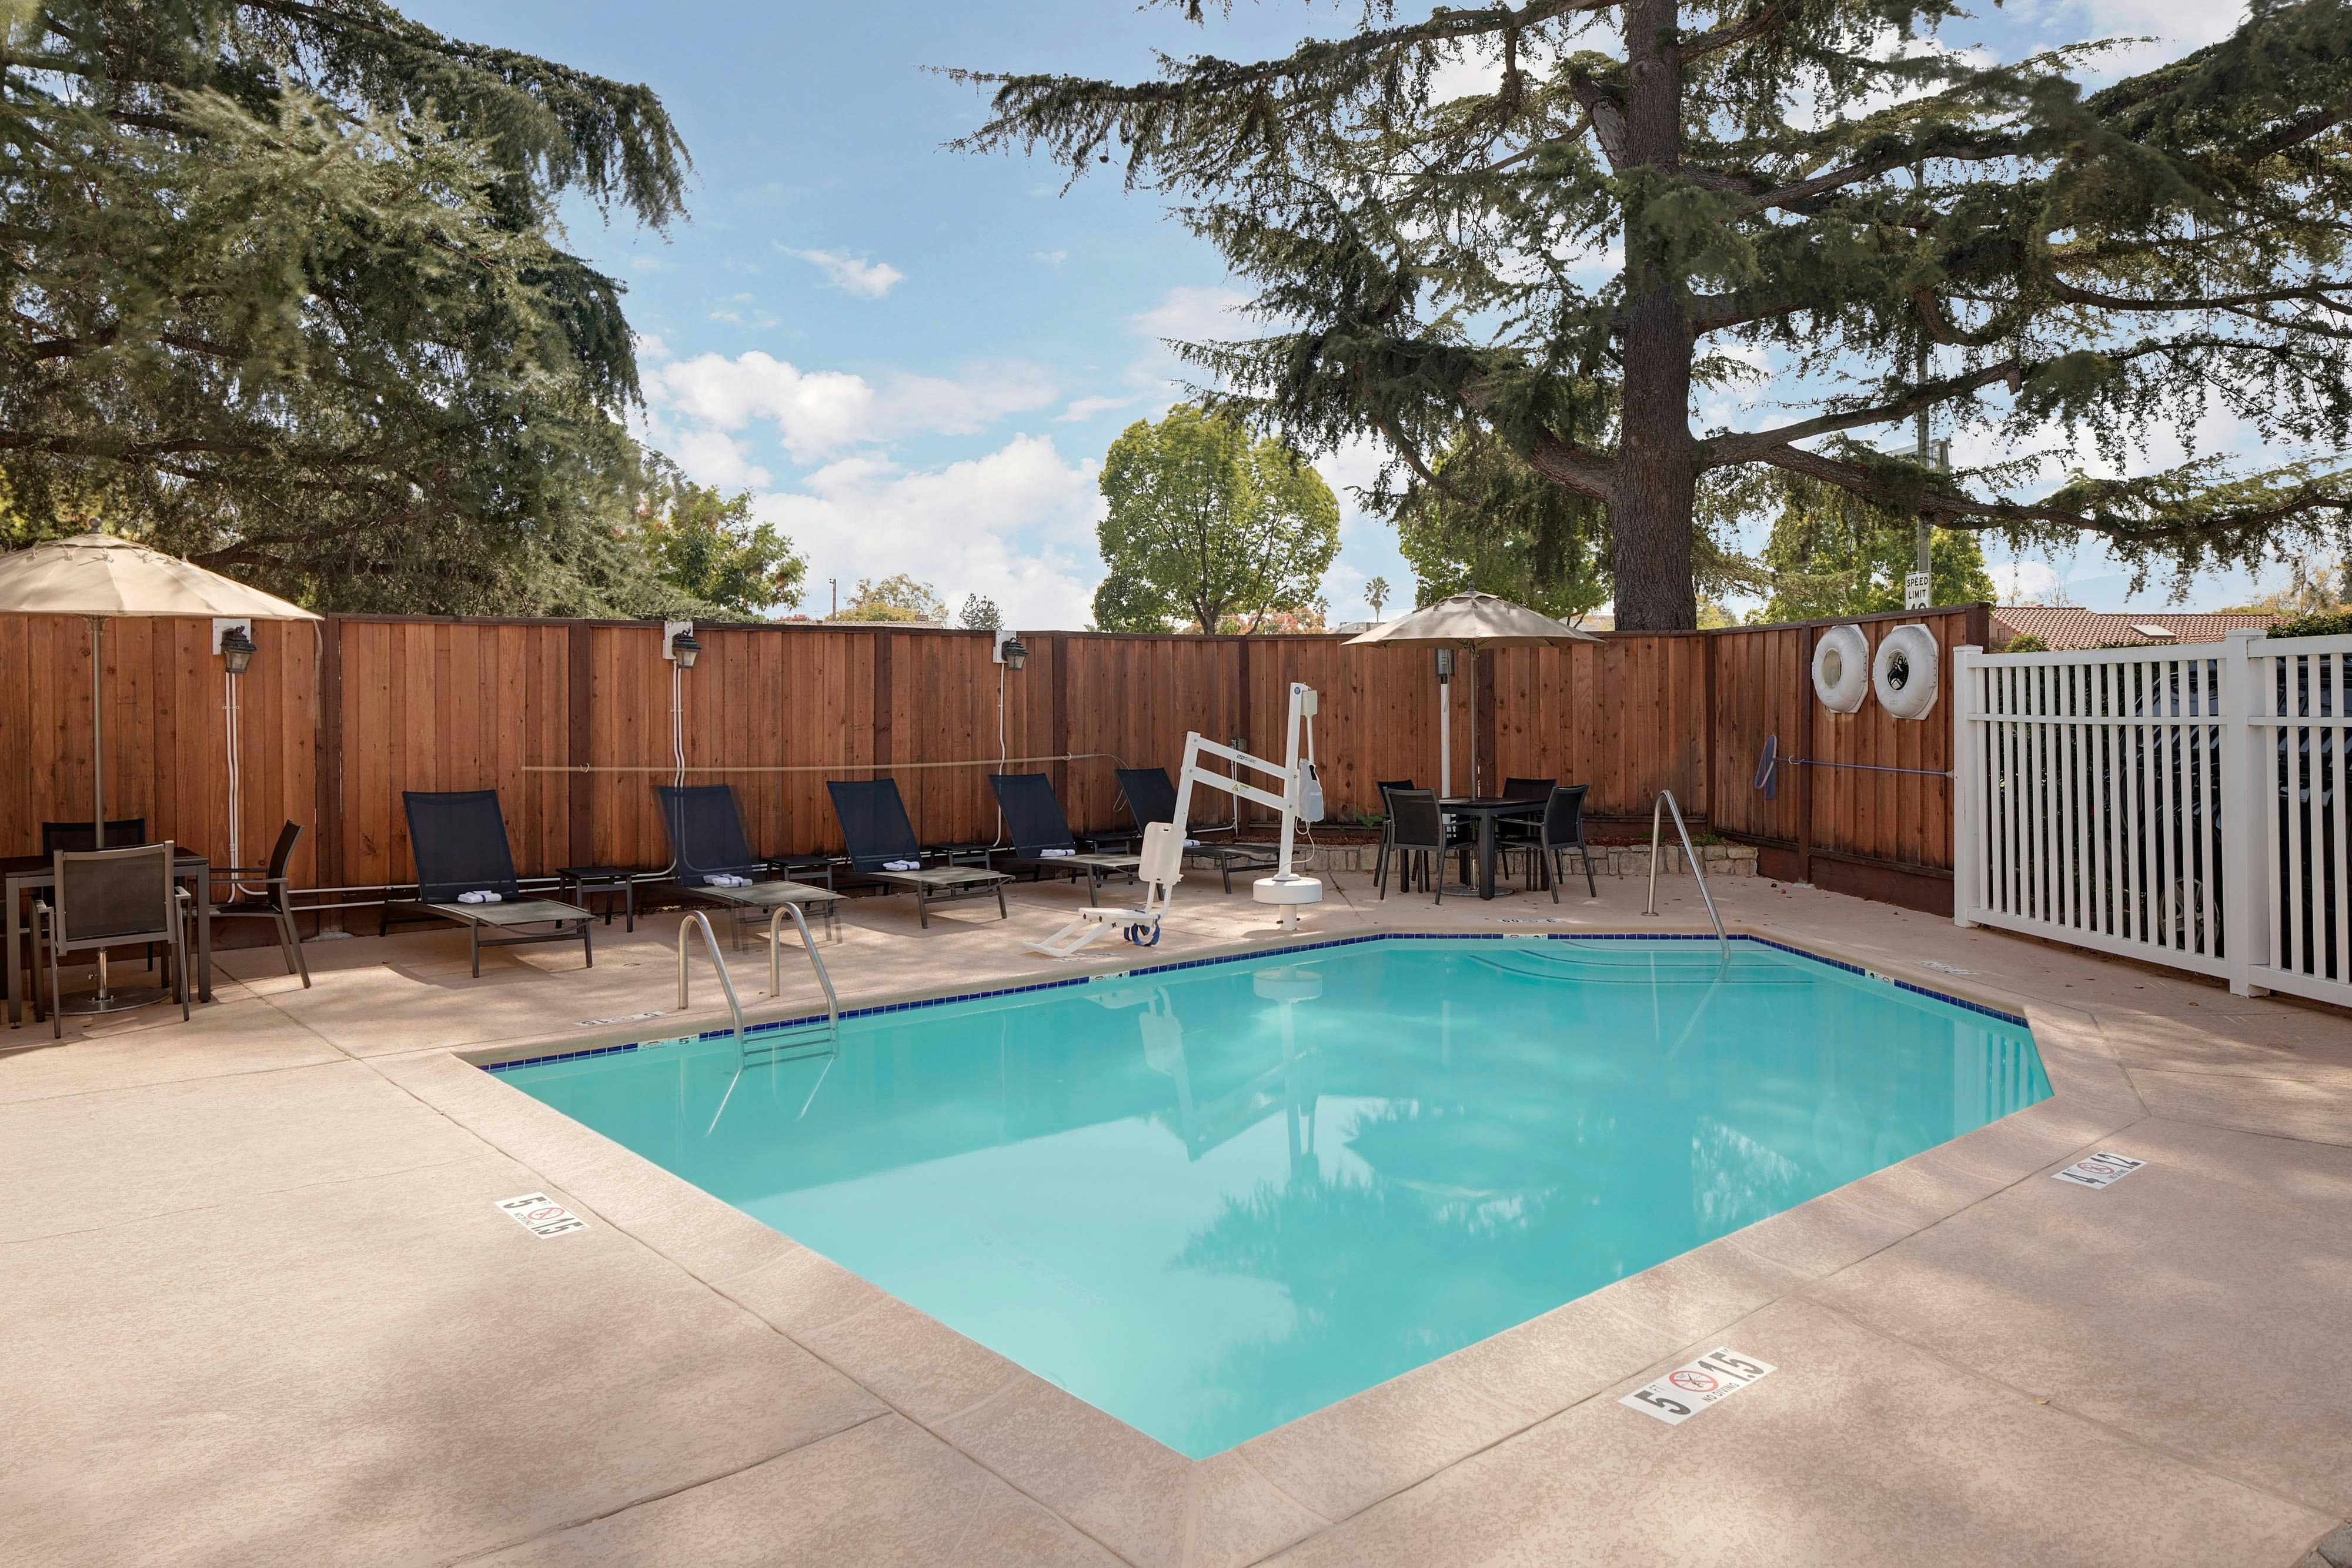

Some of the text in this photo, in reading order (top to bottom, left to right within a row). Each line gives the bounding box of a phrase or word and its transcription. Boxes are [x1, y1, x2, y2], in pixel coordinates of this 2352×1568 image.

[1907, 577, 1929, 587] SPEED
[1909, 590, 1926, 599] LIMIT
[2062, 1172, 2107, 1184] 4
[503, 1196, 547, 1209] 5
[531, 1218, 584, 1235] 1.5
[1698, 1352, 1765, 1382] 1.5
[1633, 1385, 1691, 1415] 5 FT
[1701, 1382, 1740, 1403] NO DIVING
